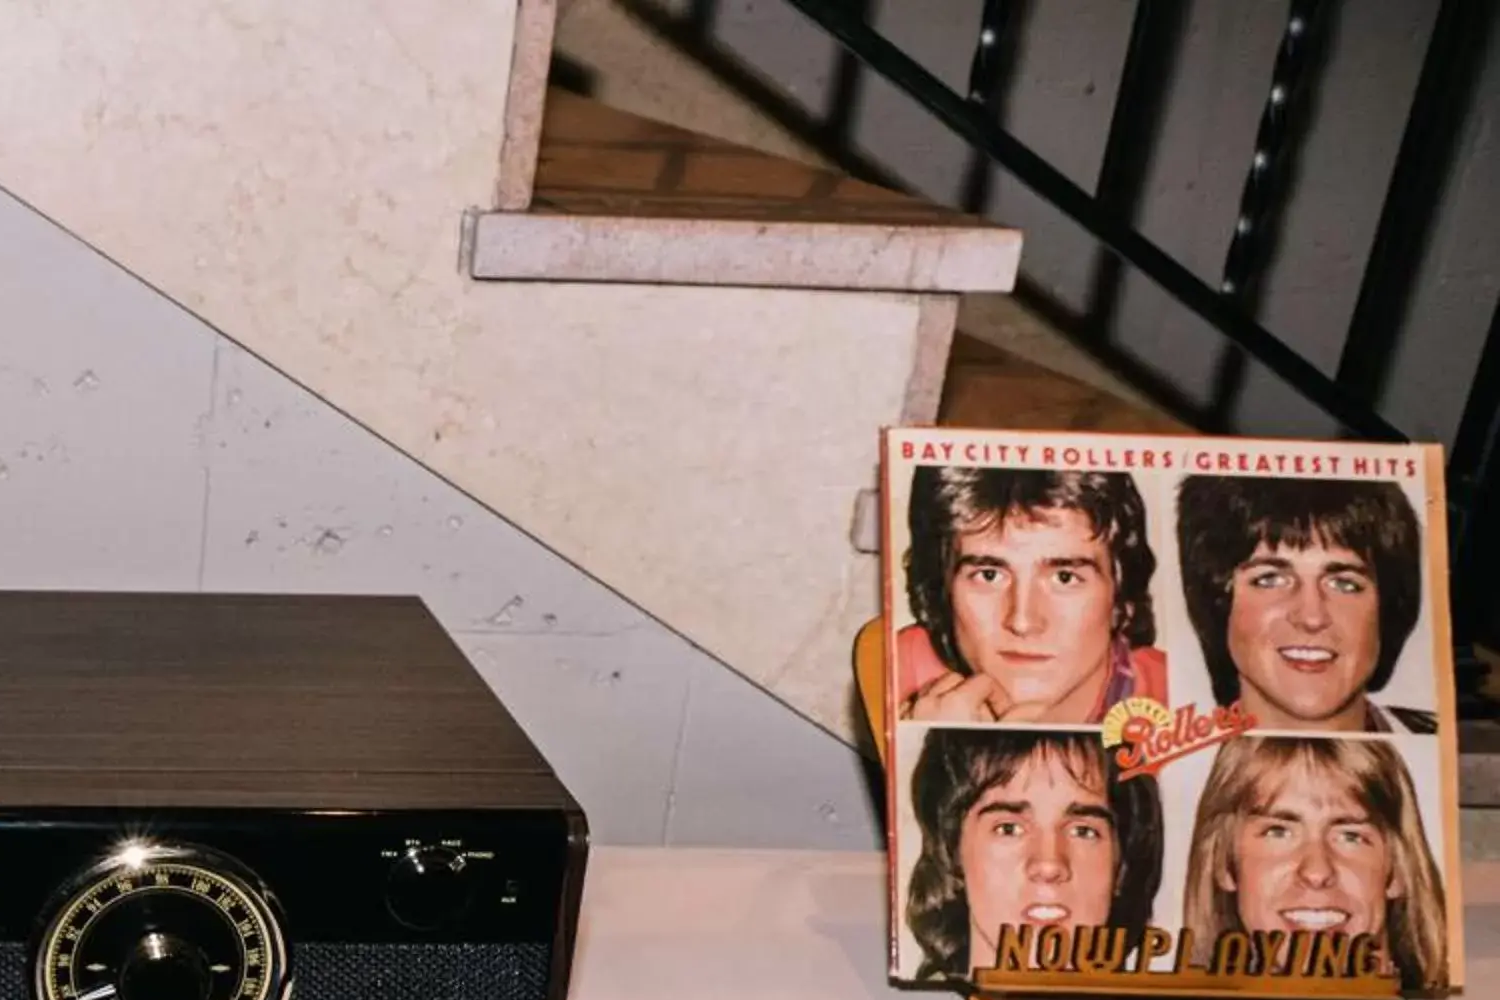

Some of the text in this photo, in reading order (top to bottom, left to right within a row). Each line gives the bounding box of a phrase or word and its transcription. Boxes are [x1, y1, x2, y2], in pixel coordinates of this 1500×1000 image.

[901, 441, 955, 461] BAY
[964, 443, 1030, 464] CITY
[1042, 446, 1174, 468] ROLLERS
[1195, 451, 1341, 474] GREATEST
[1353, 457, 1417, 477] HITS
[1115, 702, 1258, 769] Rollers
[995, 922, 1396, 980] NOW PLAYING
